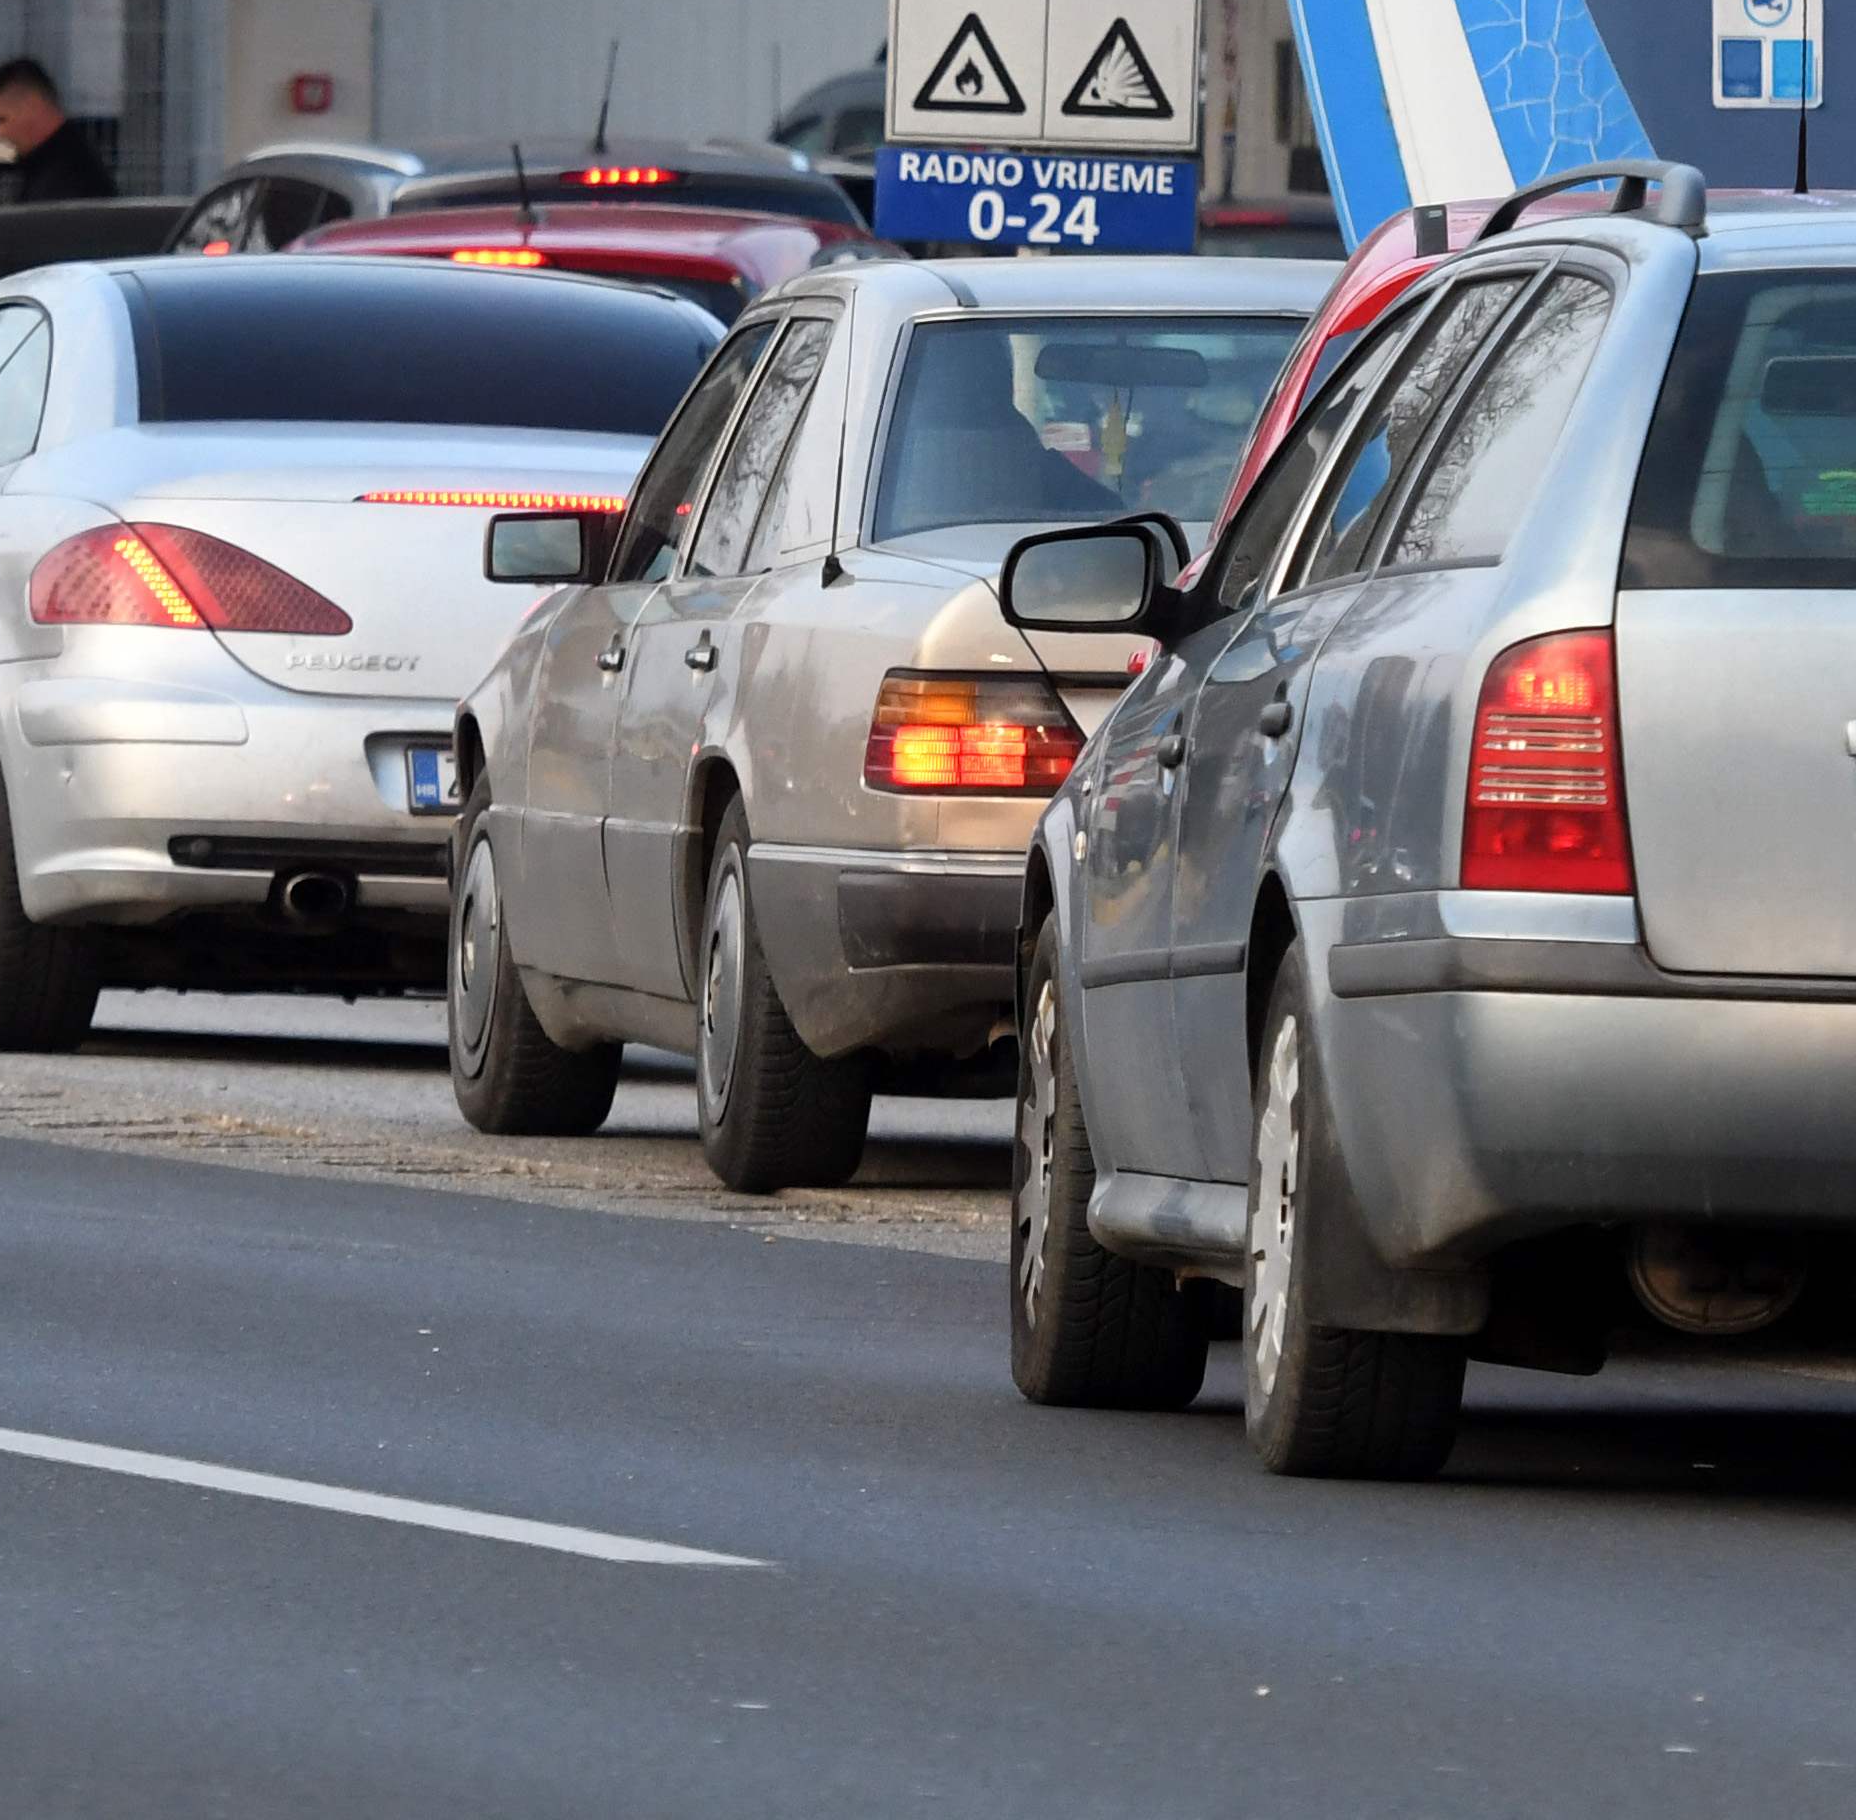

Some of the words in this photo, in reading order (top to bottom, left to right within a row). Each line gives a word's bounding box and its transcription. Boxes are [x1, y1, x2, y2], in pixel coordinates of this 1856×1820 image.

[899, 151, 1023, 188] RADNO
[1032, 157, 1174, 195] VRIJEME
[968, 190, 1100, 246] 0-24
[286, 653, 421, 672] PEUGEOT
